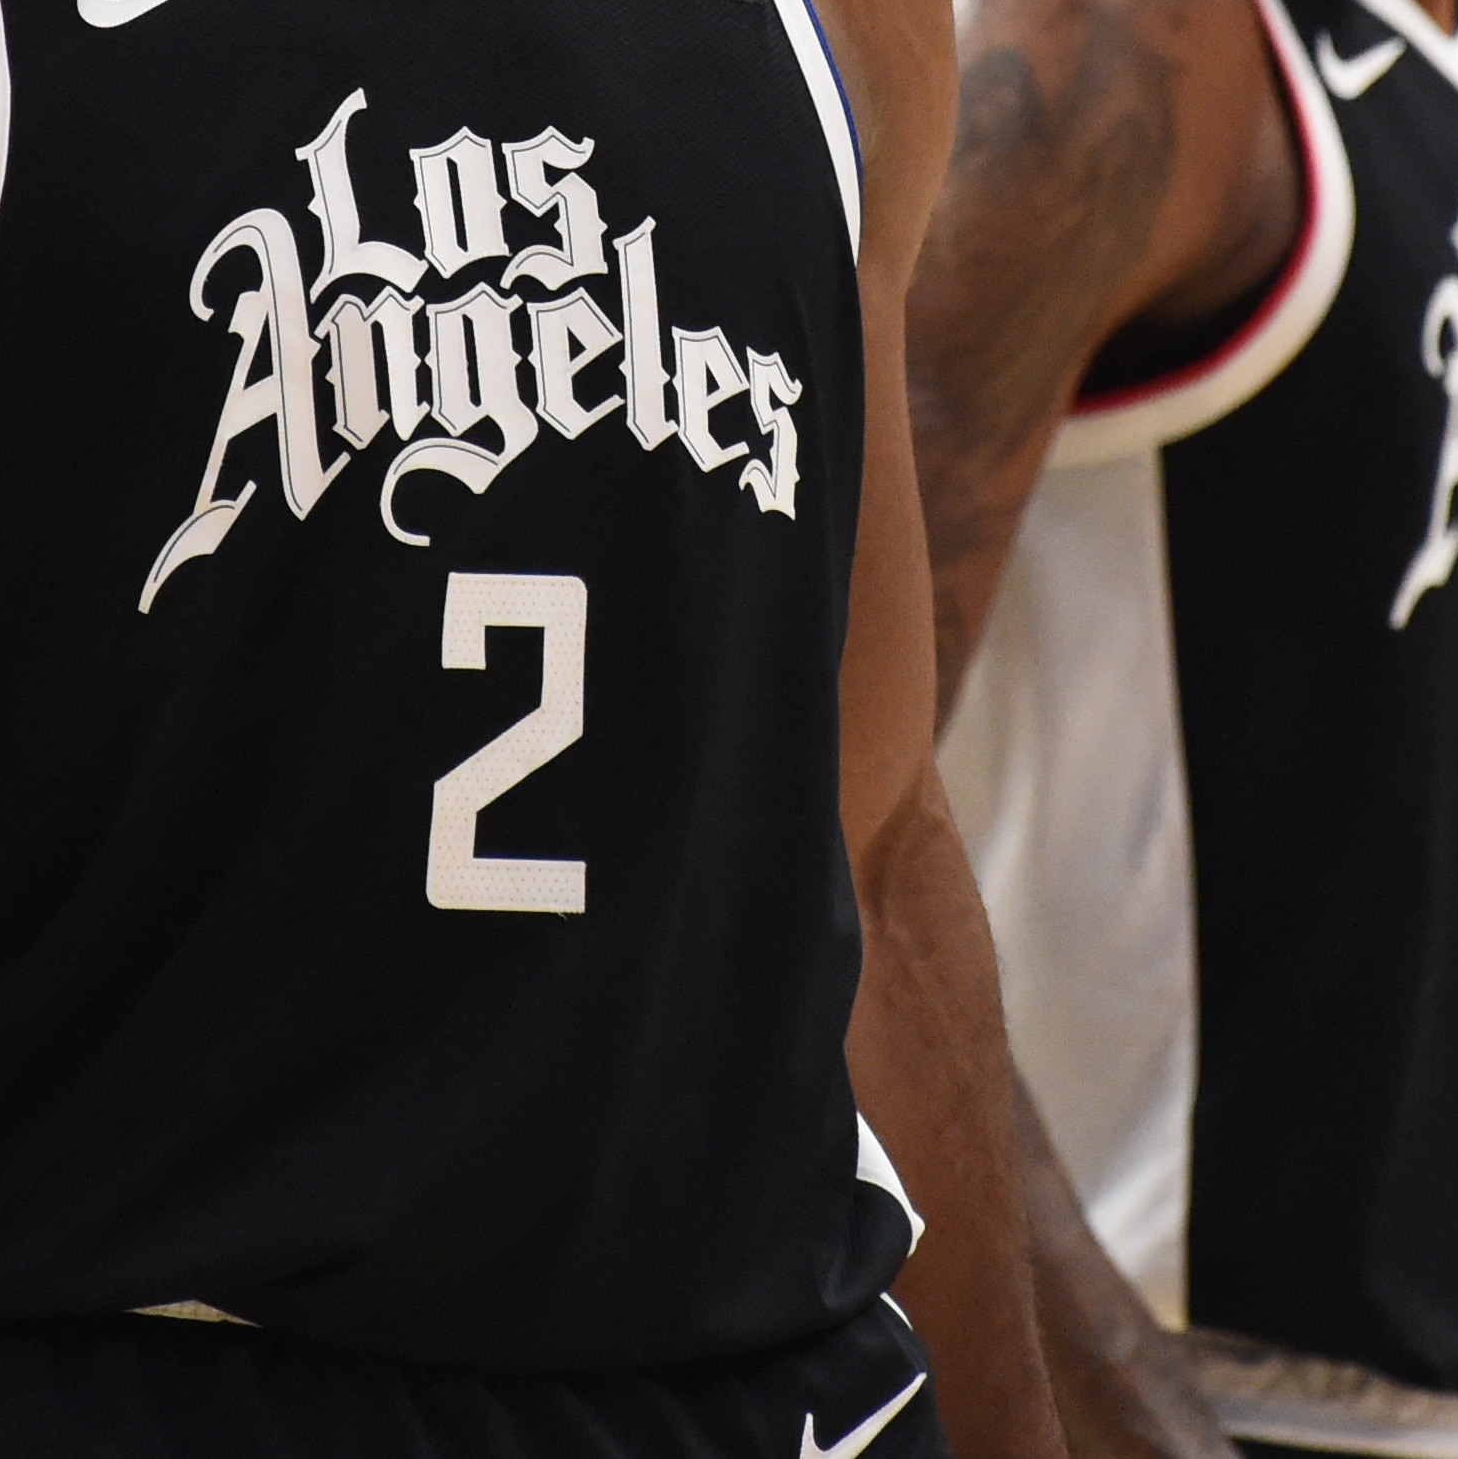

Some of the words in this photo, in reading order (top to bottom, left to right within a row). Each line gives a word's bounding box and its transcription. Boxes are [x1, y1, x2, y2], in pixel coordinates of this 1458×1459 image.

[295, 87, 608, 303] Los
[137, 208, 803, 614] Angeles
[426, 572, 588, 913] 2
